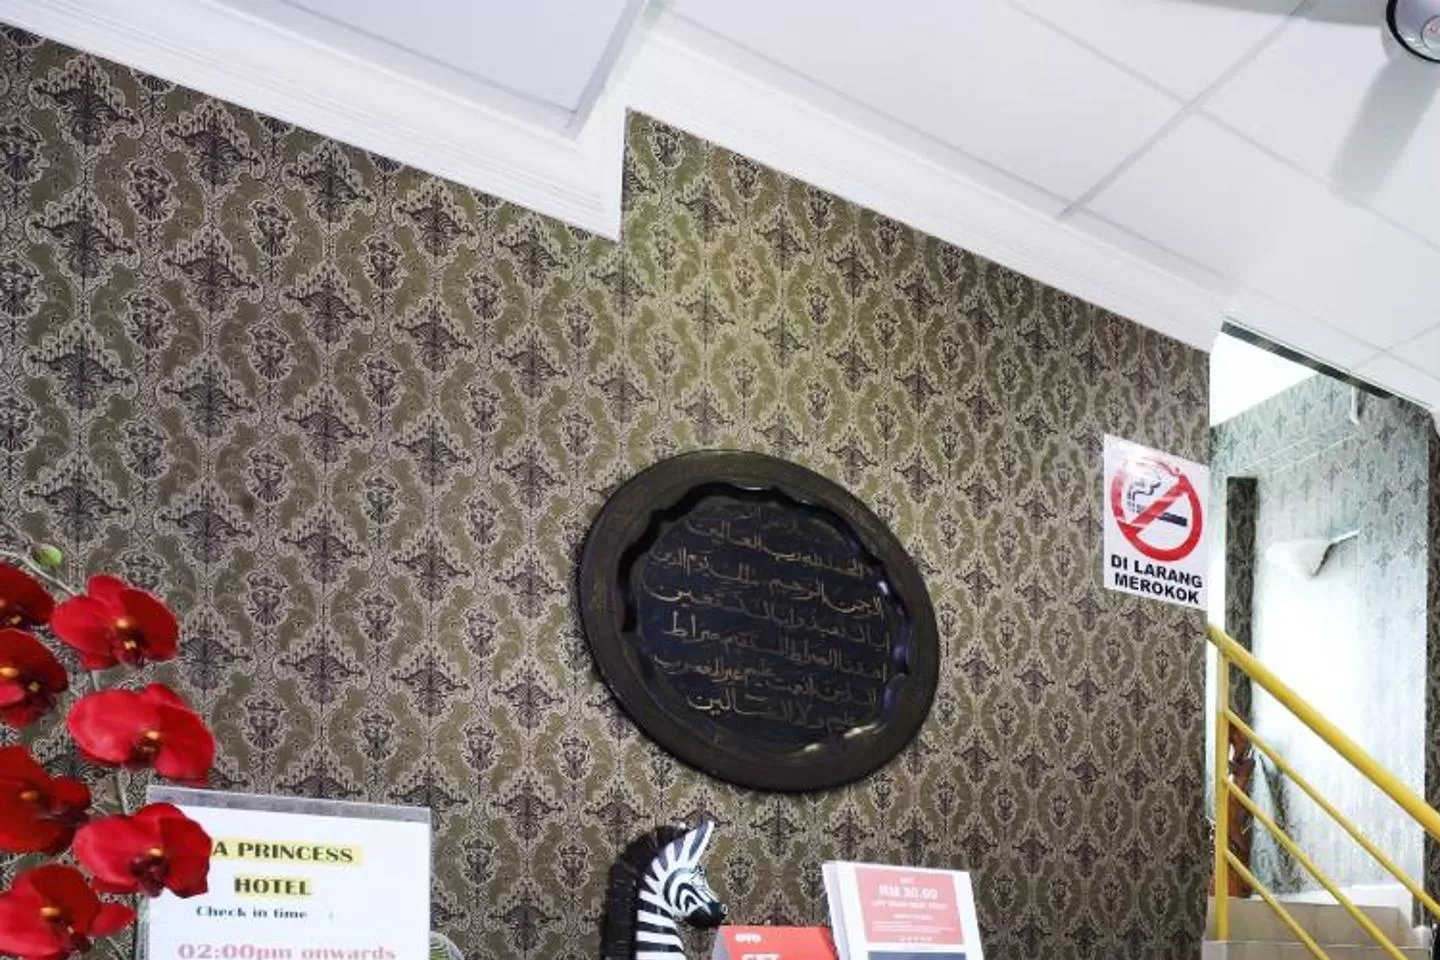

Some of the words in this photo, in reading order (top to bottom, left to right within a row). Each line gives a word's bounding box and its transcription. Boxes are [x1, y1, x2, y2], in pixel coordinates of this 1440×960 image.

[1111, 554, 1128, 571] DI
[1134, 560, 1203, 588] LARANG
[1114, 573, 1199, 604] MEROKOK
[237, 842, 354, 863] PRINCESS
[233, 877, 313, 896] HOTEL
[196, 906, 247, 918] Check
[252, 907, 268, 919] in
[273, 908, 308, 920] time
